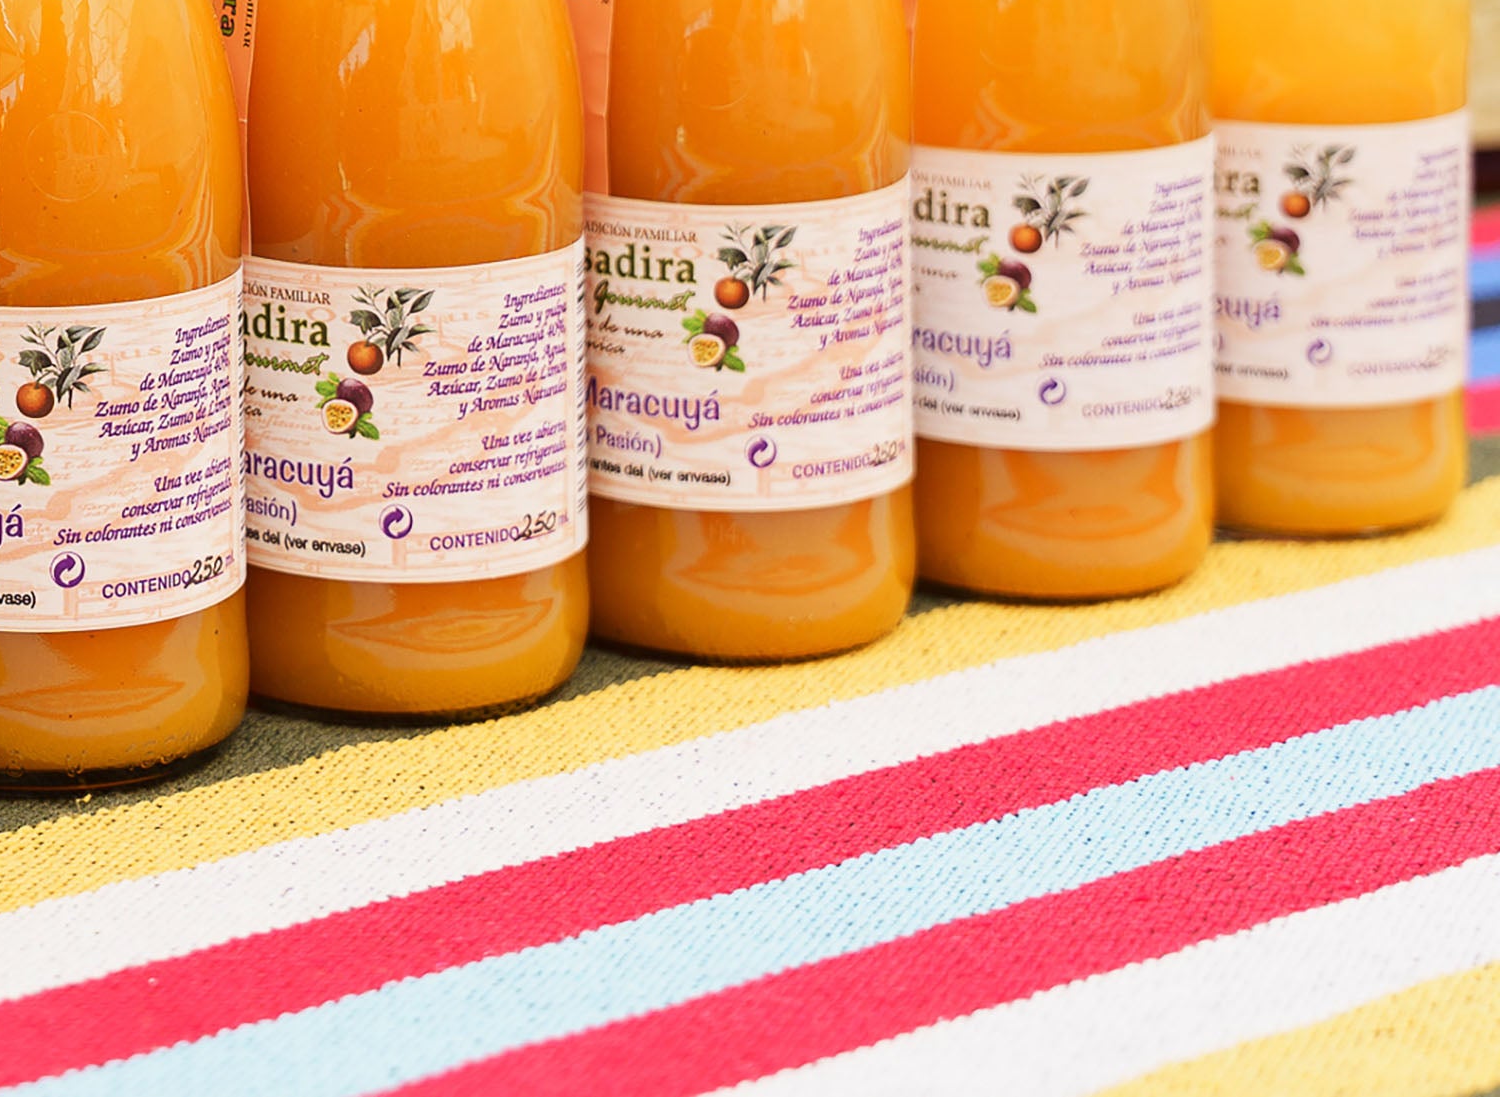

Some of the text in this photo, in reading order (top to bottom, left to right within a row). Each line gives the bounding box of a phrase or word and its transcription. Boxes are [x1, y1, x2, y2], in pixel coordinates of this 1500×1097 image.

[634, 227, 697, 242] FAMILIAR
[270, 287, 331, 304] FAMILIAR
[788, 295, 827, 309] Zumo
[498, 311, 542, 329] Zumo y
[468, 335, 482, 353] de
[170, 347, 211, 365] Zumo y
[423, 355, 485, 376] Zumo de
[140, 373, 155, 391] de
[427, 366, 538, 396] Azúcar, Zumo de
[95, 393, 158, 418] Zumo de
[261, 389, 298, 402] una
[458, 395, 519, 420] y Aromas
[99, 402, 206, 438] Azúcar, Zumo de
[748, 412, 773, 428] Sin
[129, 432, 191, 462] y Aromas
[482, 431, 532, 450] Una vez
[596, 424, 662, 459] Pasión)
[449, 454, 512, 474] conservar
[624, 463, 644, 477] del
[649, 466, 672, 482] (ver
[792, 454, 870, 479] CONTENIDO
[154, 470, 202, 492] Una vez
[382, 473, 500, 498] Sin colorantes ni
[122, 496, 184, 519] conservar
[53, 516, 172, 546] Sin colorantes ni
[430, 526, 519, 550] CONTENIDO
[262, 529, 366, 558] del (ver envase)
[102, 570, 191, 599] CONTENIDO
